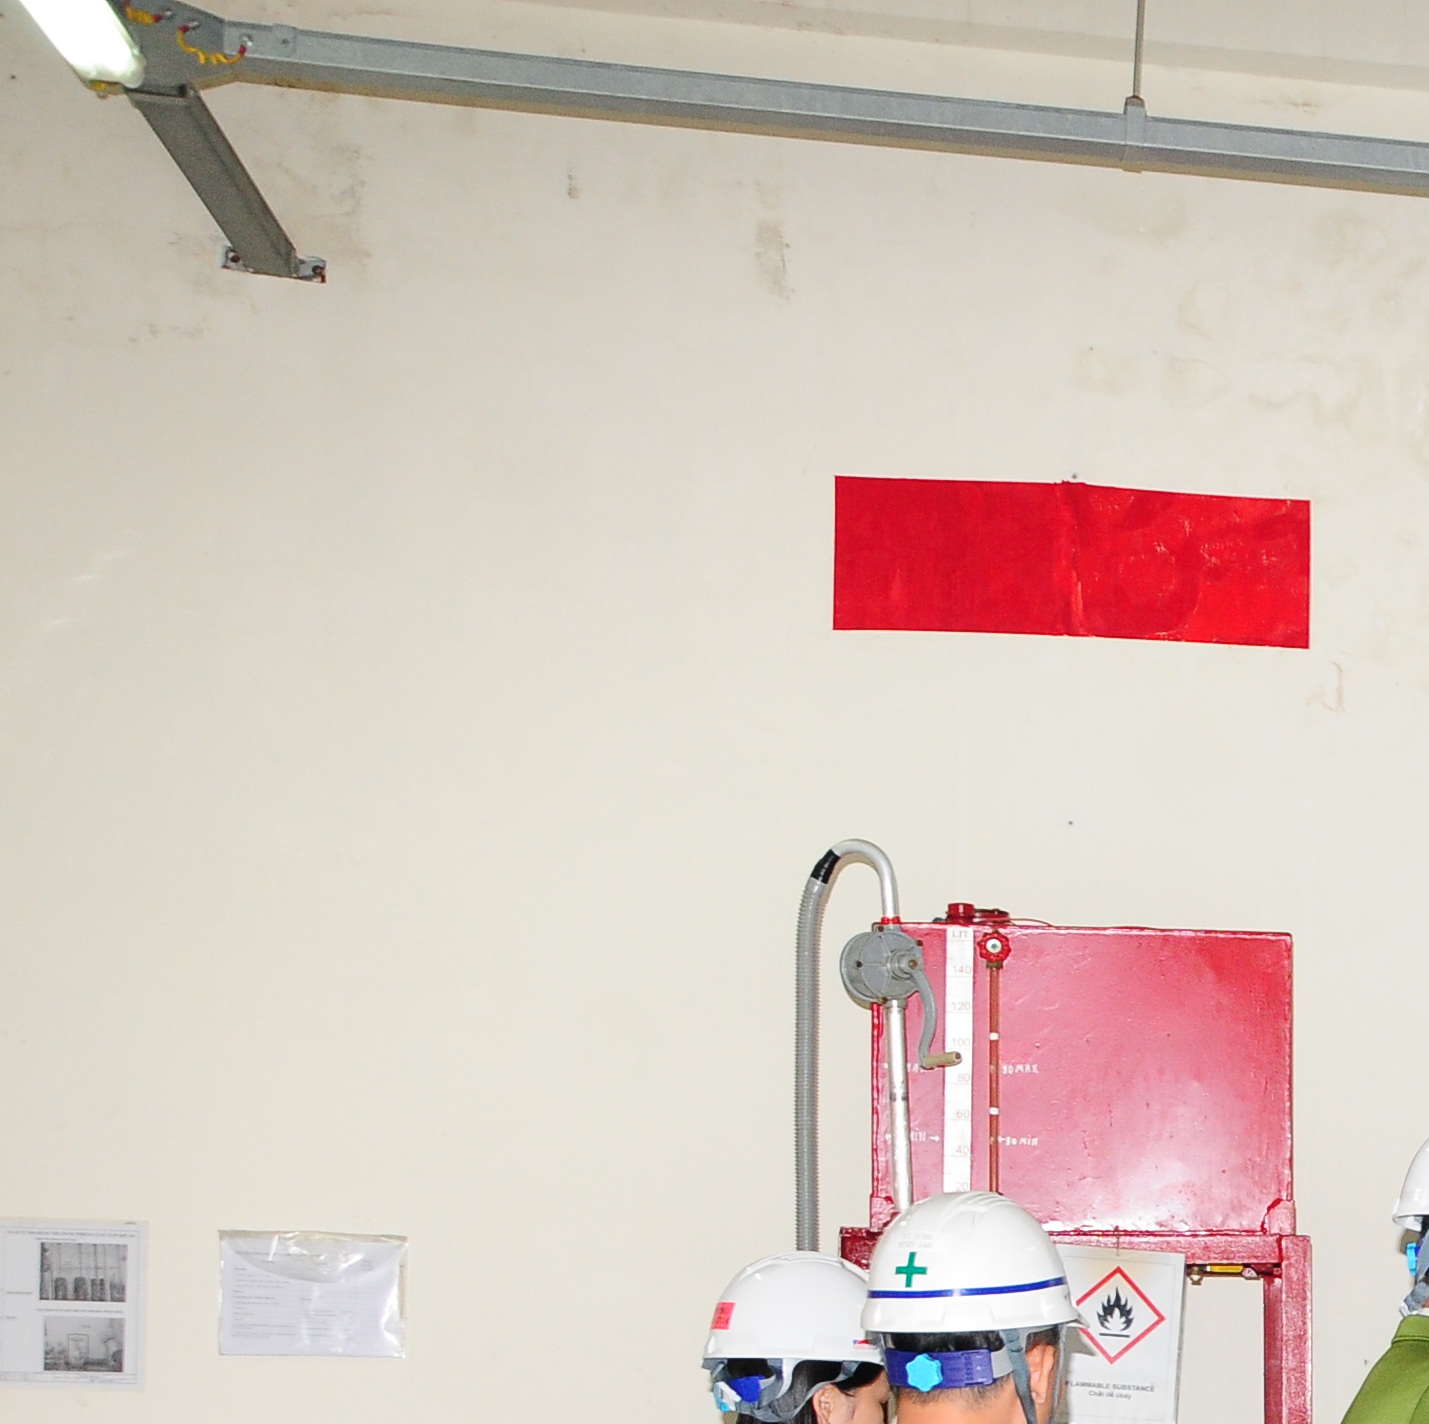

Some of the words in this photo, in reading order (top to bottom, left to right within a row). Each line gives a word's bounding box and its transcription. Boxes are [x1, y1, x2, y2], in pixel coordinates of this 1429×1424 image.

[952, 965, 971, 975] 140
[952, 1001, 971, 1011] 120
[952, 1038, 971, 1047] 100
[957, 1073, 970, 1083] 80
[956, 1109, 970, 1119] 60
[956, 1145, 969, 1155] 40
[1112, 1383, 1155, 1392] SUBSTANCE
